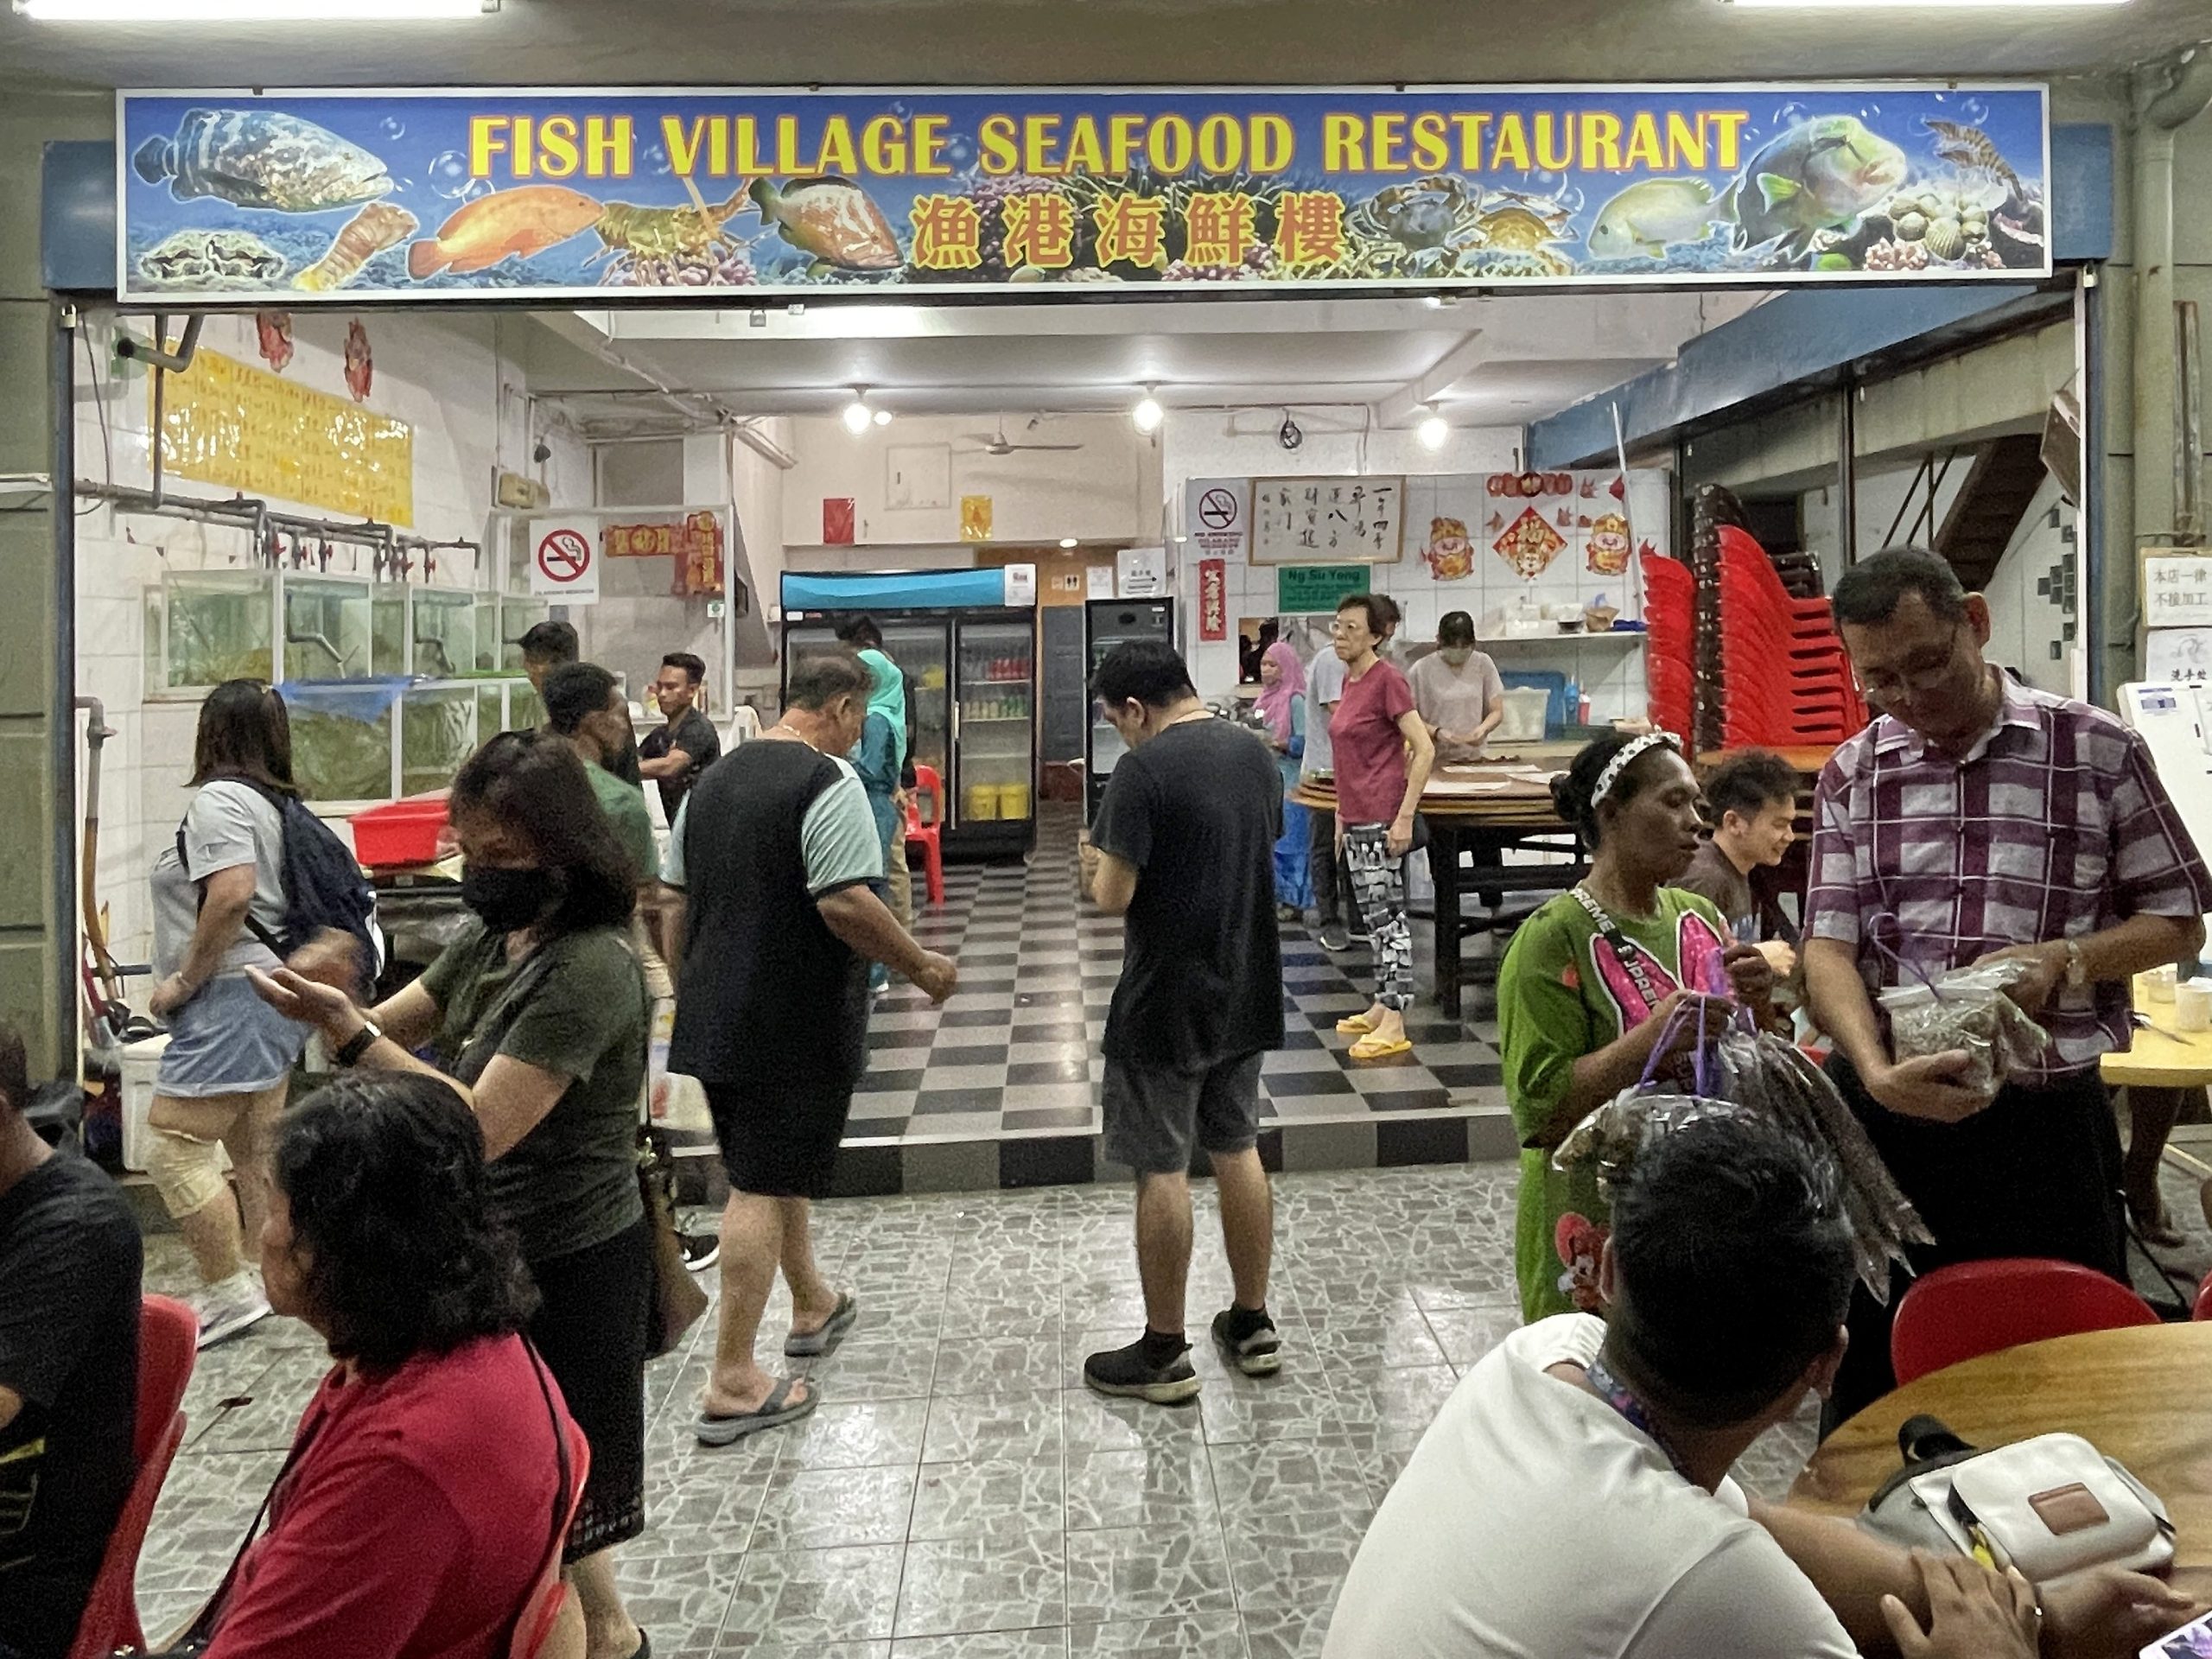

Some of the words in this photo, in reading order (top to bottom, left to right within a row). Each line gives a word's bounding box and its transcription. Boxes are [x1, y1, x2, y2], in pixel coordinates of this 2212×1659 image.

[469, 114, 633, 179] FISH
[661, 114, 953, 179] VILLAGE
[977, 112, 1294, 176] SEAFOOD
[1322, 110, 1751, 175] RESTAURANT
[911, 191, 1346, 270] 漁港海鮮樓
